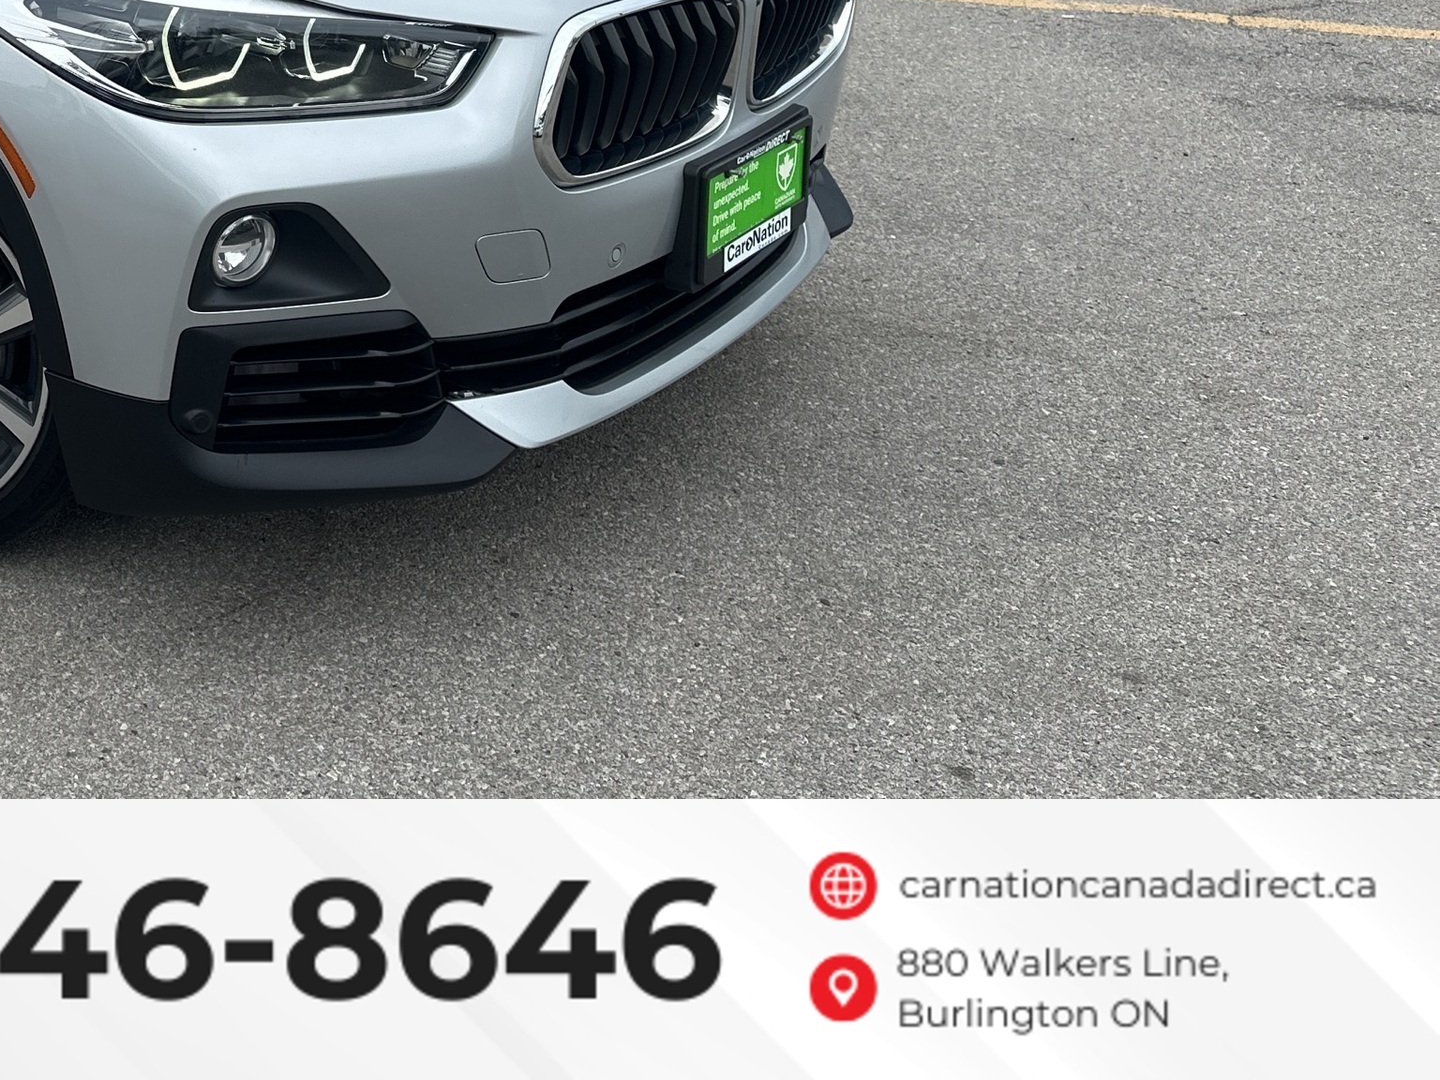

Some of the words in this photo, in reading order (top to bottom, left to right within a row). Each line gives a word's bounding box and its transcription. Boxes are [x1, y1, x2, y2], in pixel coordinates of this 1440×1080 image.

[765, 129, 791, 152] DIRECT
[713, 179, 750, 210] unexpected.
[712, 211, 729, 228] Drive
[729, 199, 743, 217] with
[743, 190, 762, 211] peace
[711, 228, 720, 244] of
[719, 218, 737, 239] mind.
